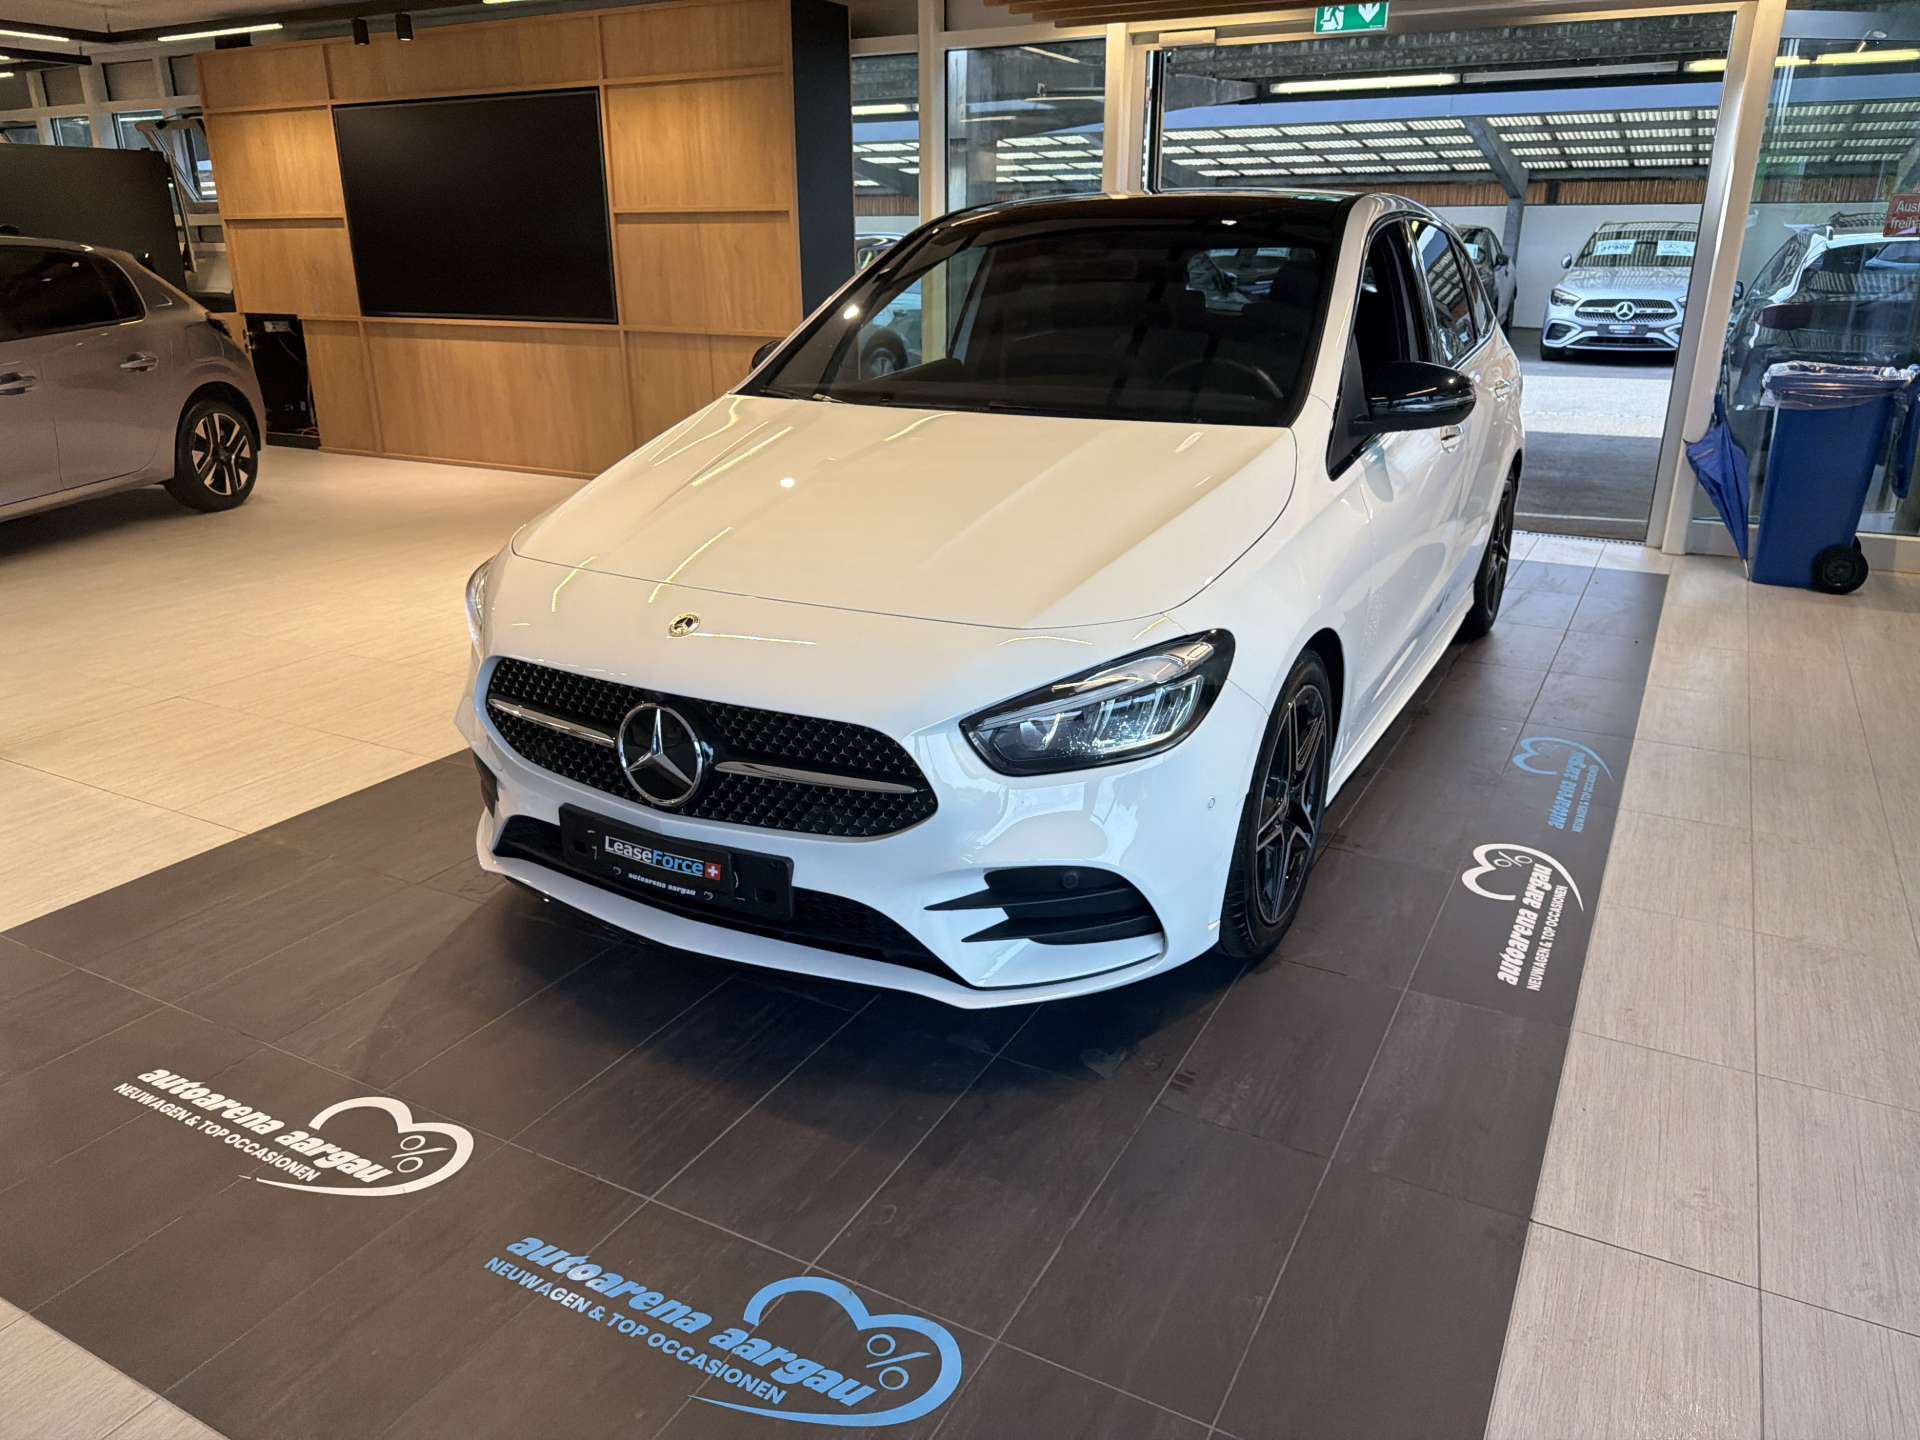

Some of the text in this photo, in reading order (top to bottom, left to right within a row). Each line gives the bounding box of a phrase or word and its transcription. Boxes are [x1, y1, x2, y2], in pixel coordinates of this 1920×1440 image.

[604, 835, 704, 877] LeaseForce
[1497, 863, 1553, 986] autoarena aargau
[1526, 946, 1551, 991] NEUWAGEN
[1539, 940, 1553, 949] &
[1541, 926, 1556, 941] TOP
[113, 1082, 321, 1182] NEUWAGEN & TOP OCCASIONEN
[137, 1069, 393, 1183] autoarena aargau
[483, 1256, 788, 1405] NEUWAGEN & TOP OCCASIONEN
[506, 1237, 878, 1407] autoarena aargau
